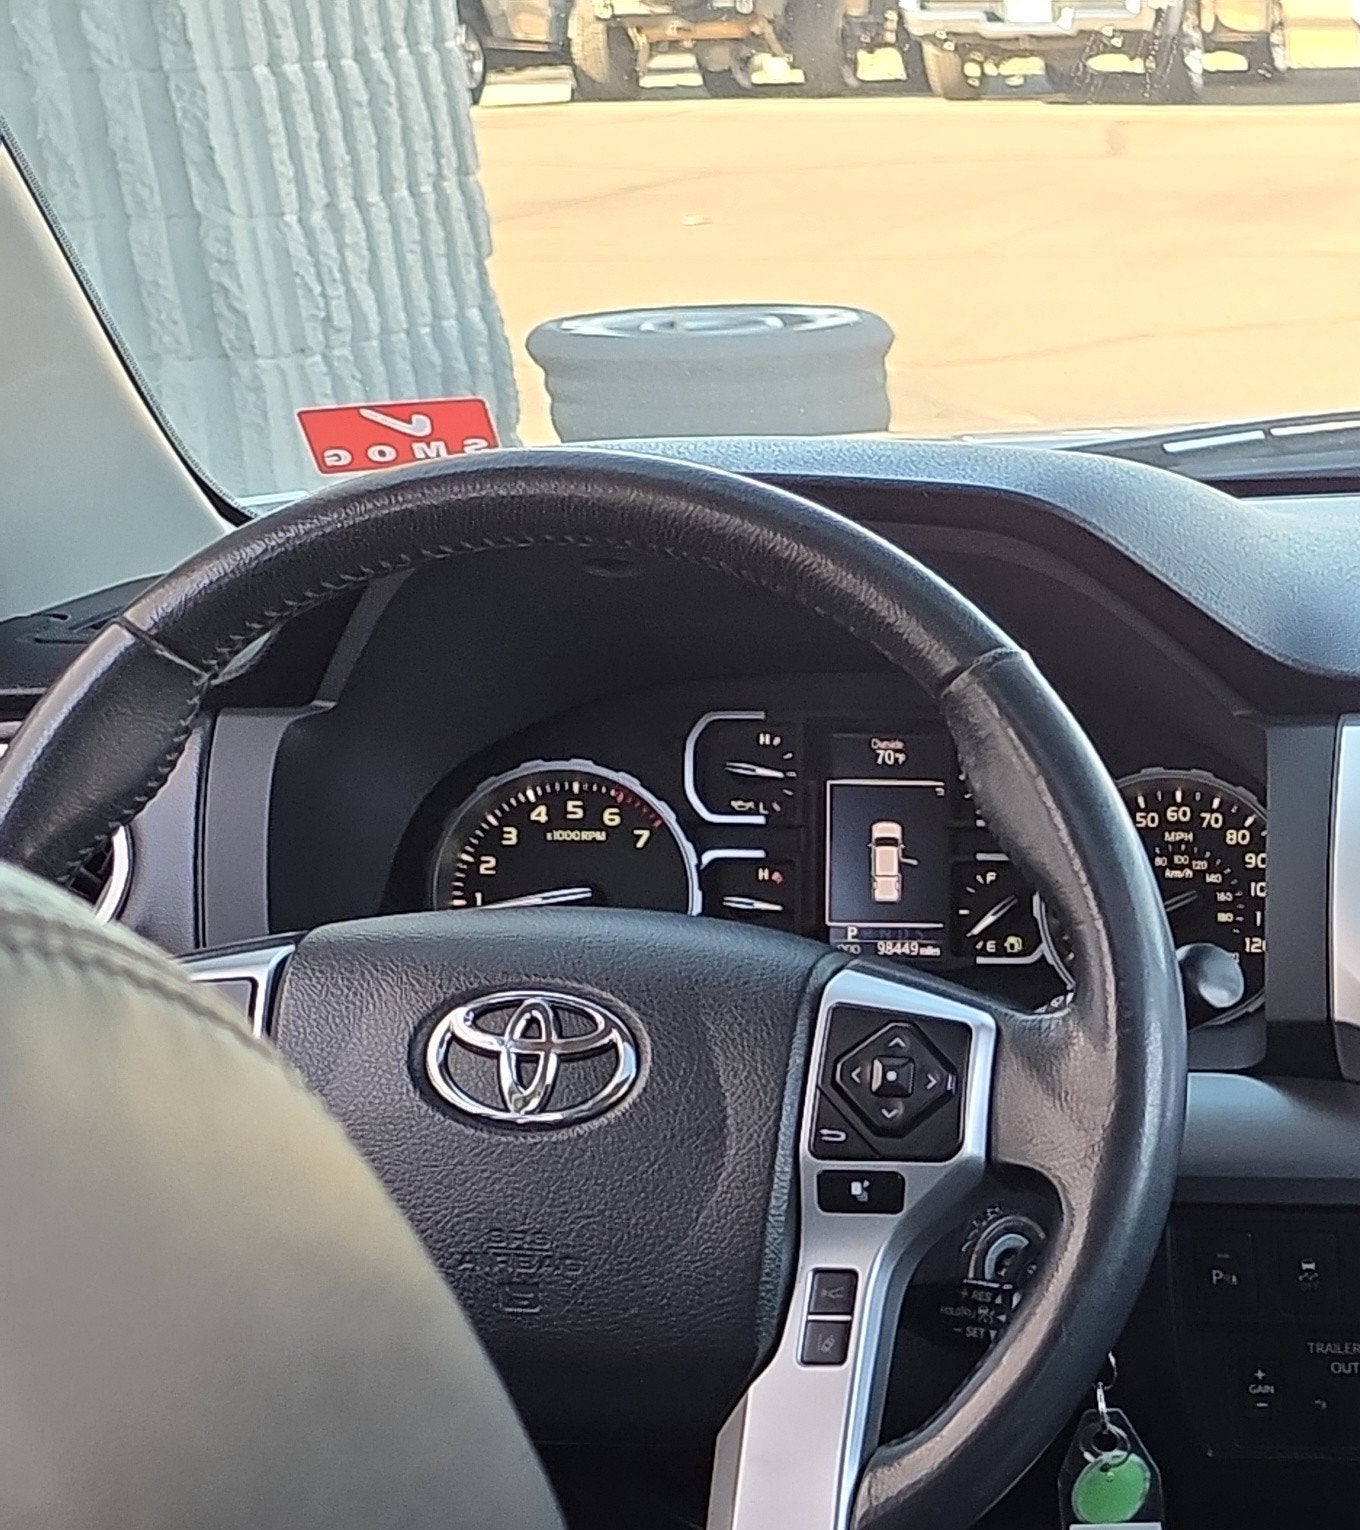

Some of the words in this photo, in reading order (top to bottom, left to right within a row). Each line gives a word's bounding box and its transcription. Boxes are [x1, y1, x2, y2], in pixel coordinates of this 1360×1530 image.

[530, 805, 548, 823] 4
[566, 801, 584, 819] 5
[603, 808, 621, 826] 6
[1166, 806, 1191, 822] 60
[1135, 812, 1159, 828] 50
[1200, 812, 1223, 828] 70
[501, 826, 518, 845] 3
[633, 830, 651, 848] 7
[1164, 831, 1193, 843] MPH
[1225, 829, 1250, 845] 80
[479, 856, 496, 875] 2
[847, 927, 858, 941] P
[876, 940, 918, 956] 98449
[1307, 1342, 1360, 1354] TRAILER
[1247, 1384, 1275, 1395] GAIN
